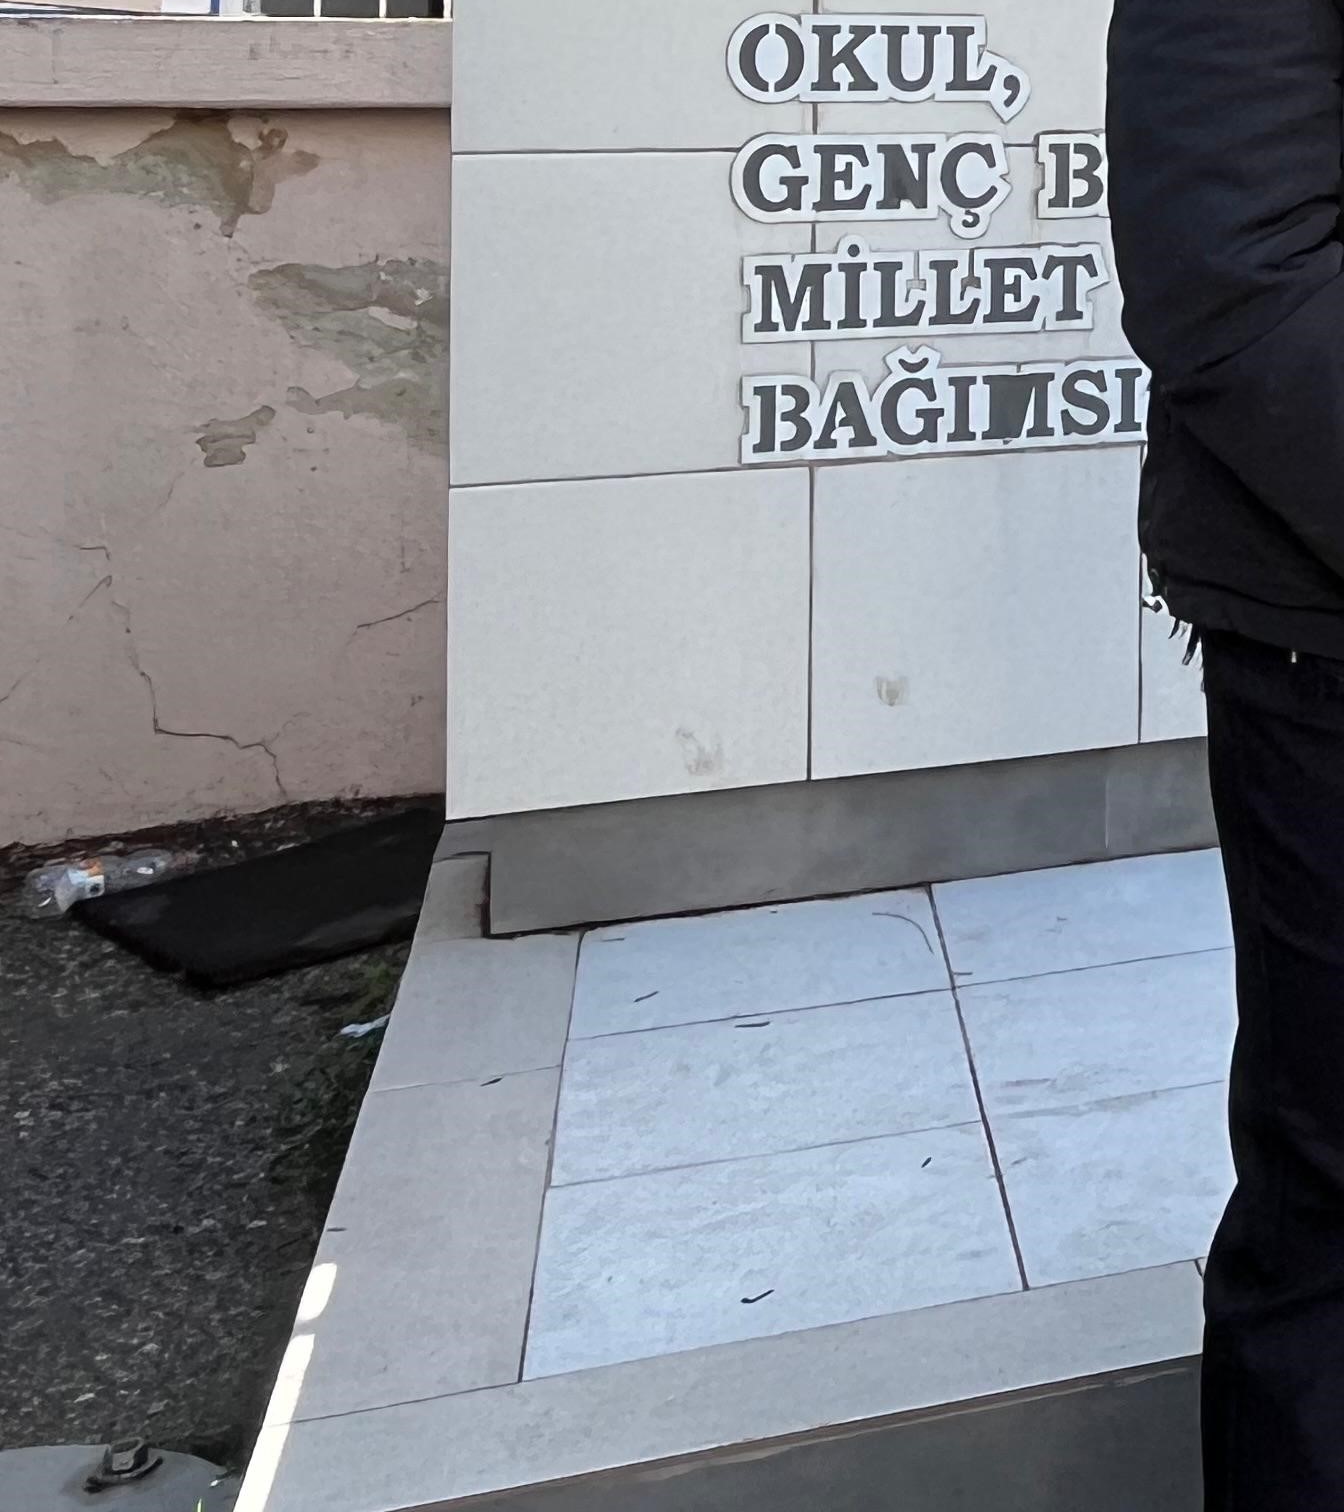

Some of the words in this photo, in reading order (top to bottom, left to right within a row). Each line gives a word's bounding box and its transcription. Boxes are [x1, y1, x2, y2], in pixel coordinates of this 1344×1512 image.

[738, 23, 1021, 108] OKUL,
[742, 142, 998, 229] GENÇ
[753, 243, 1098, 333] MİLLET
